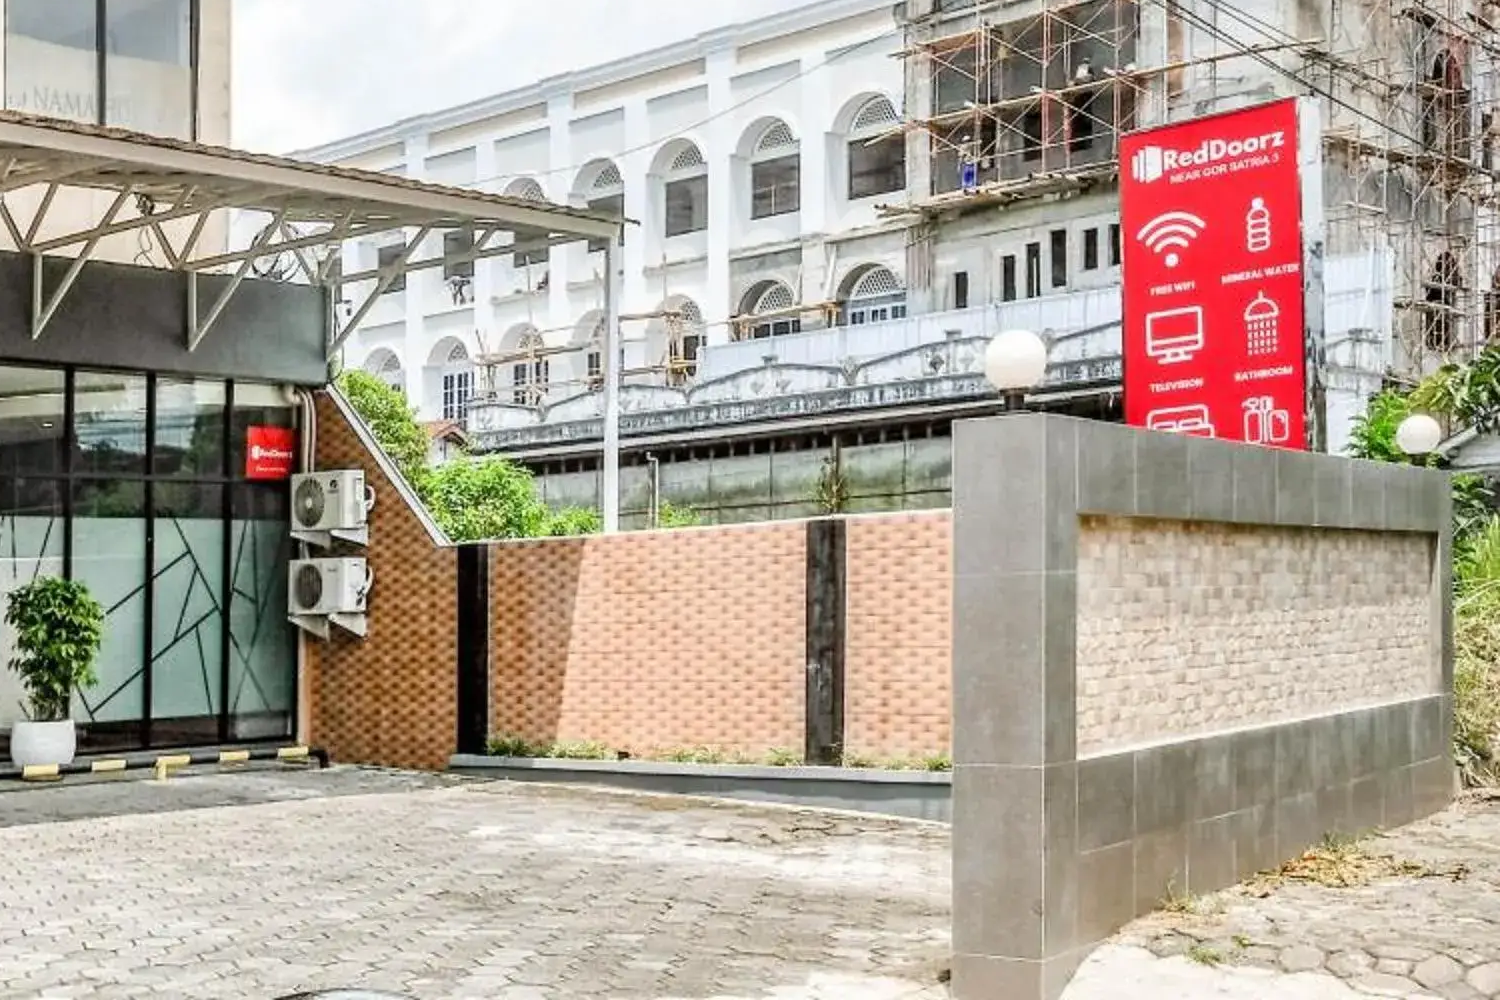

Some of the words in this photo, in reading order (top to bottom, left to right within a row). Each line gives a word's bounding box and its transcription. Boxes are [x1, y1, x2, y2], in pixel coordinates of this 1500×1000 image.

[1164, 131, 1284, 170] RedDoorz
[1169, 170, 1202, 184] NEAR
[1229, 157, 1270, 172] SATRIA
[1221, 272, 1264, 285] MINERAL
[1264, 264, 1300, 277] WATER
[1150, 284, 1173, 296] FREE
[1234, 365, 1294, 382] BATHROOM
[1150, 378, 1204, 393] TELEVISION
